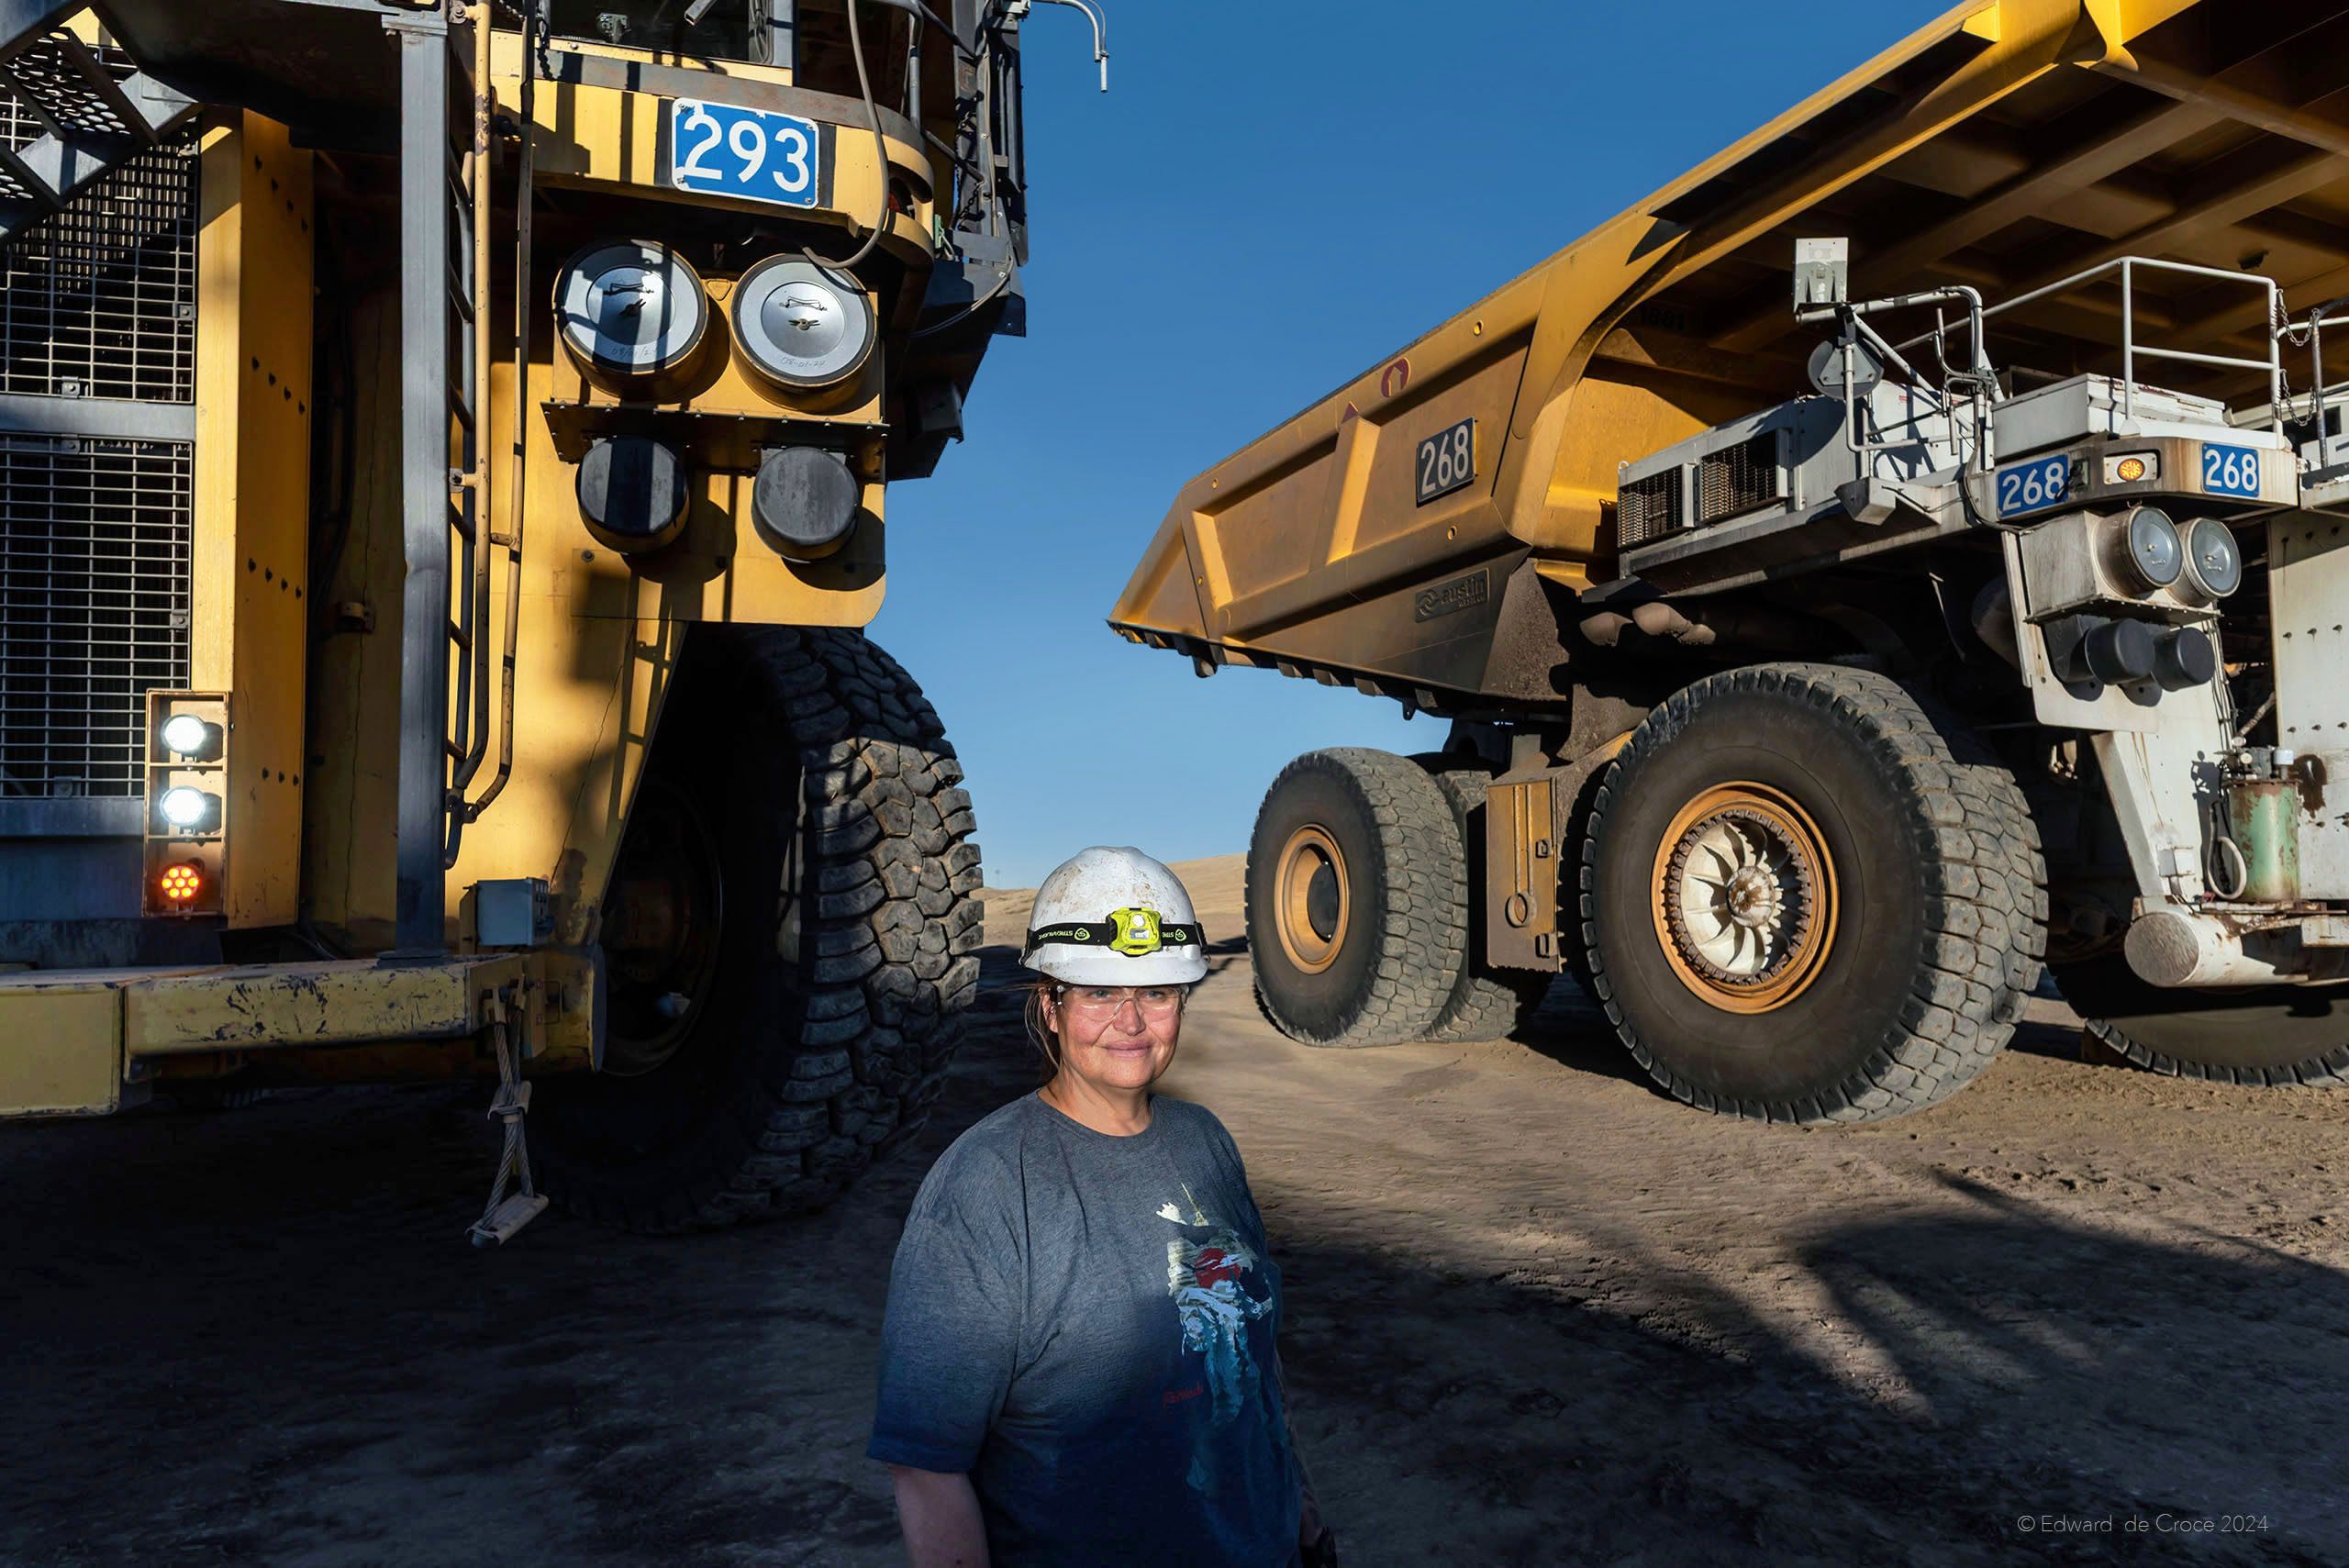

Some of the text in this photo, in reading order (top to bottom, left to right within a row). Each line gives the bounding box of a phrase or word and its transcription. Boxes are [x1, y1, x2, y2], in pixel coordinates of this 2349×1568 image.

[684, 113, 809, 194] 293
[1420, 424, 1469, 496] 268
[2002, 461, 2065, 511] 268
[2204, 448, 2257, 492] 268
